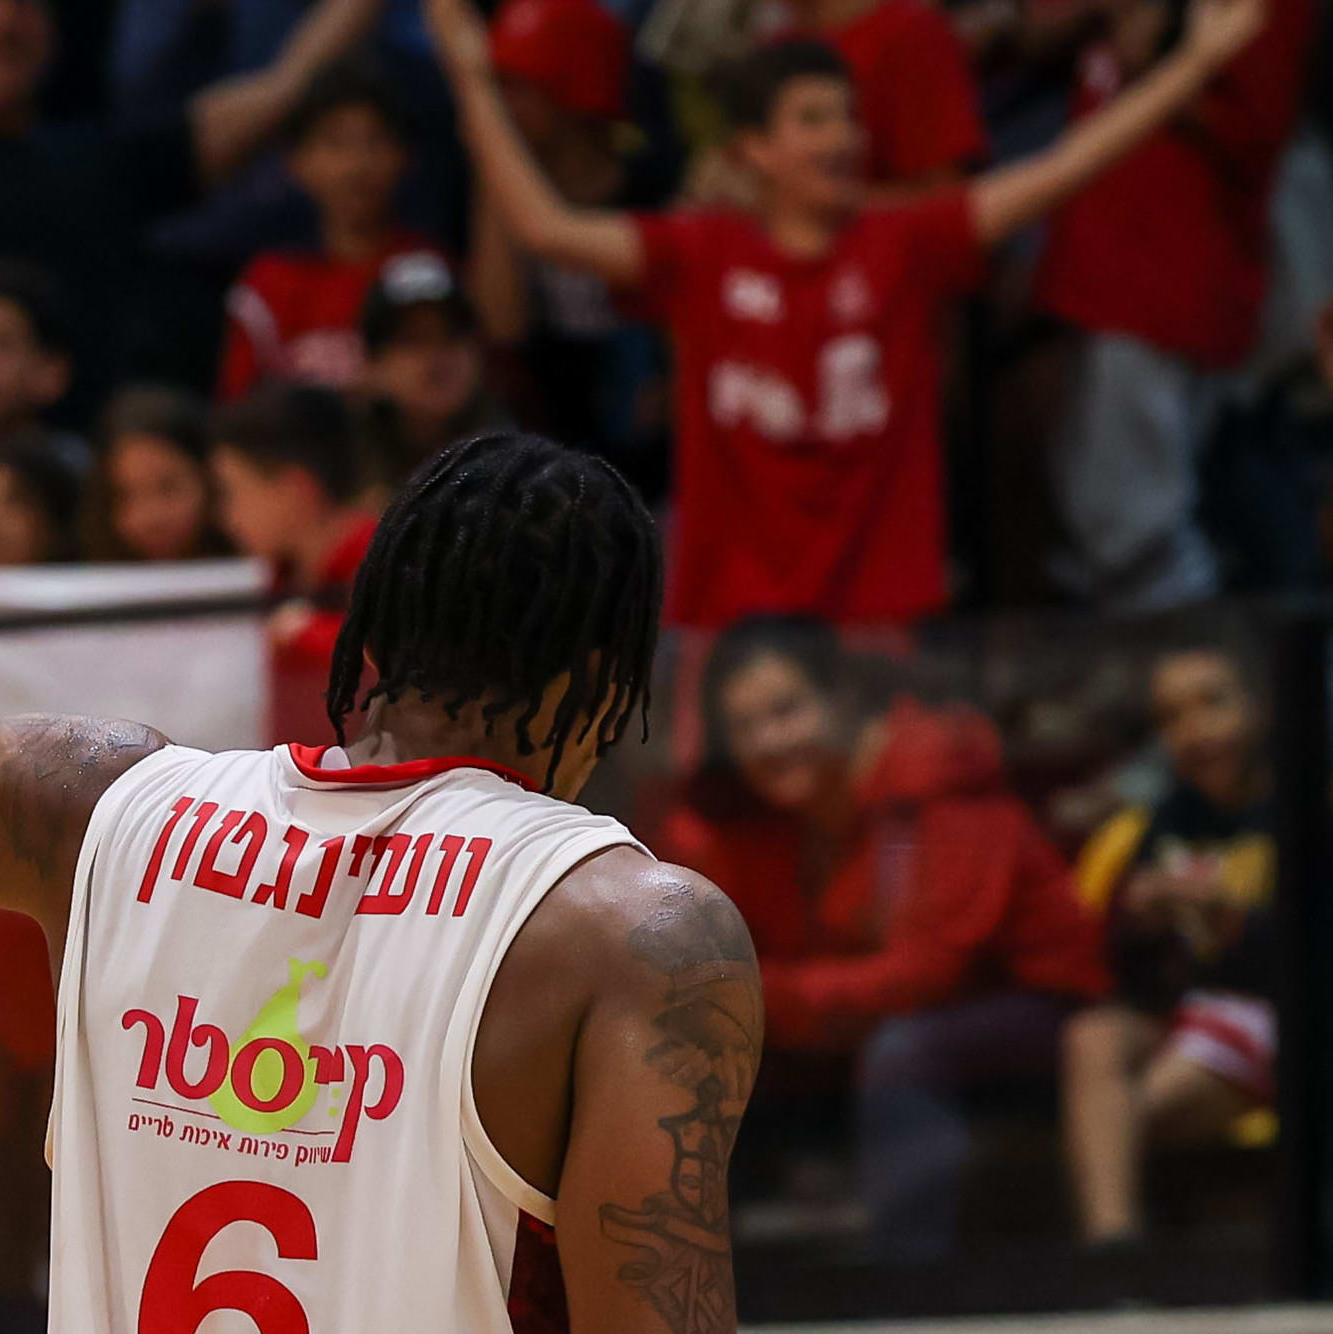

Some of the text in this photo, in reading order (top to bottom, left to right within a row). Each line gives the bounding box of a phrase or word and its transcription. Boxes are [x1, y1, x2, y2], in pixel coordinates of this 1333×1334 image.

[136, 796, 494, 919] וושינגטון
[121, 994, 405, 1164] מייסטר
[128, 1114, 174, 1137] טריים
[180, 1125, 232, 1150] איכות
[237, 1137, 289, 1160] פירות
